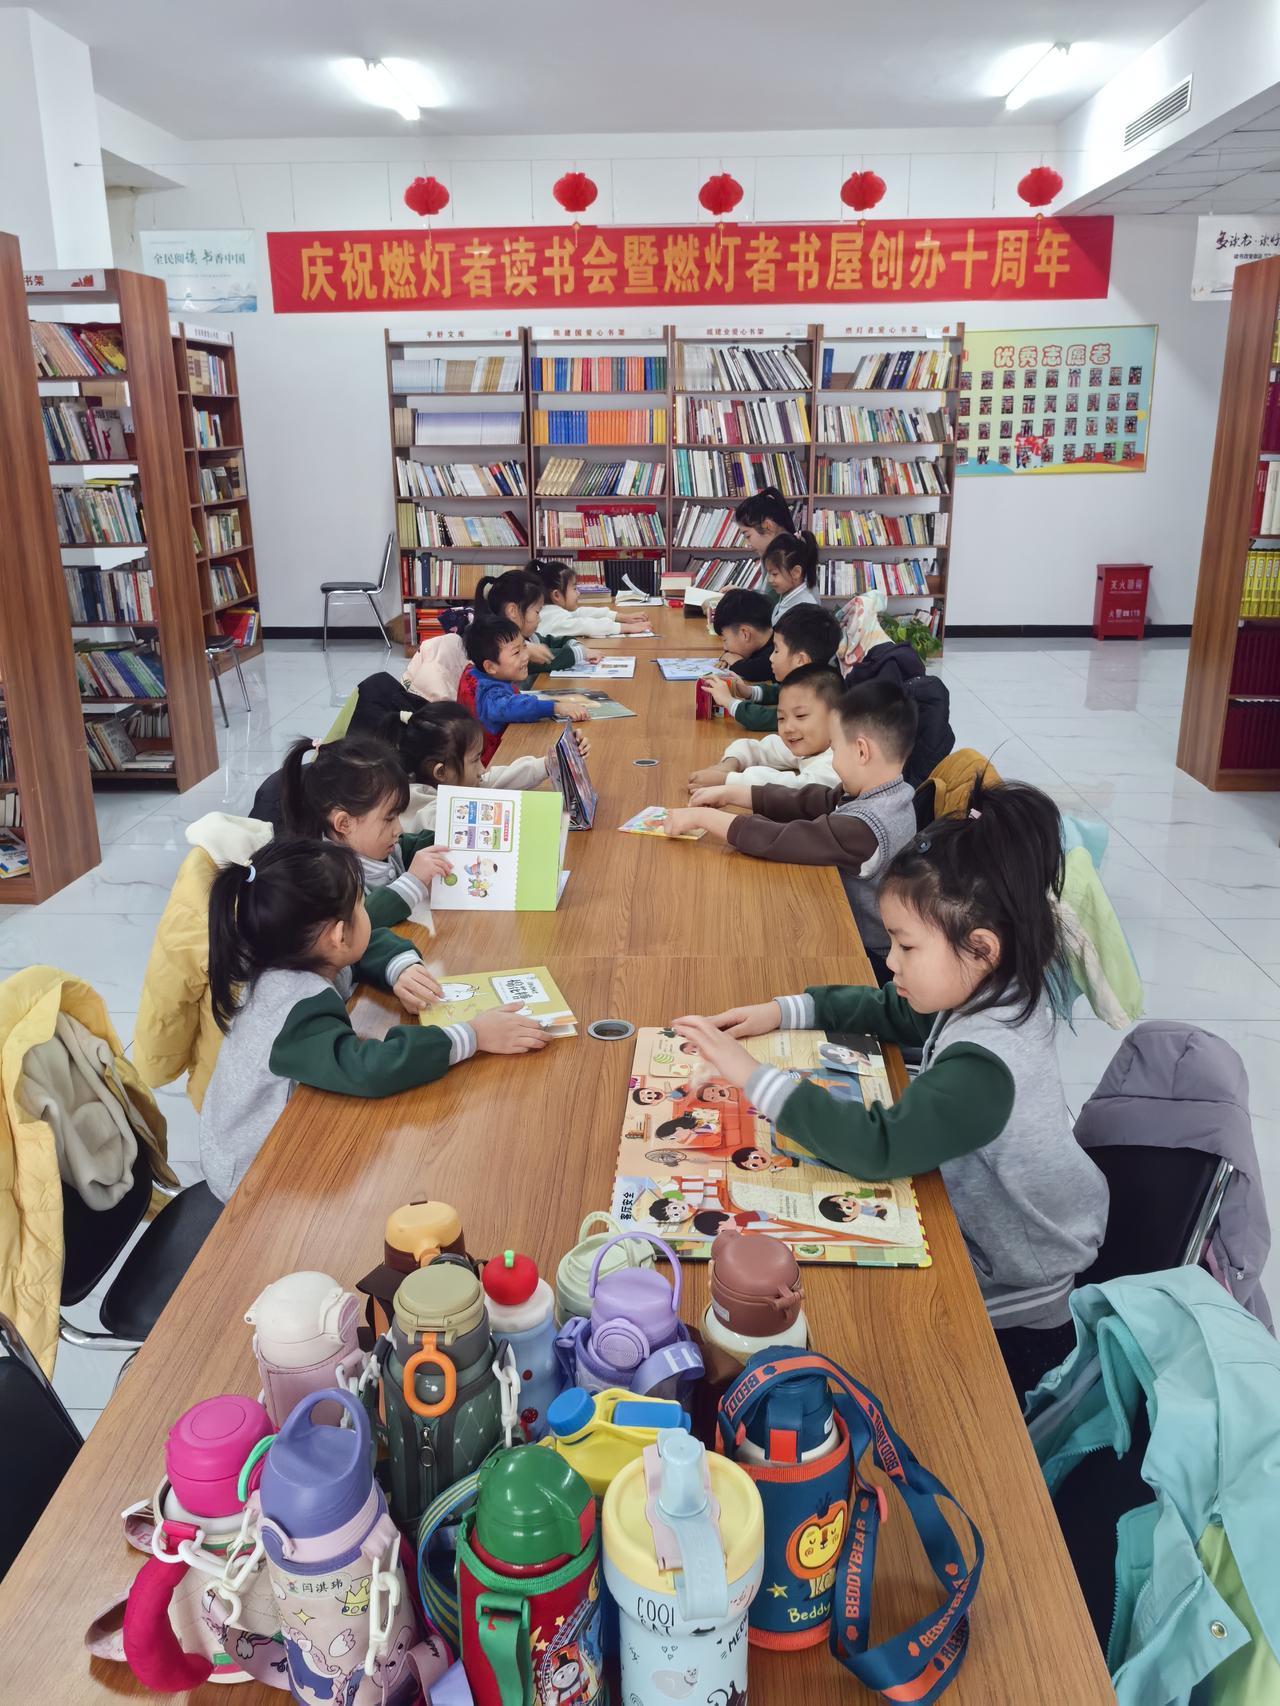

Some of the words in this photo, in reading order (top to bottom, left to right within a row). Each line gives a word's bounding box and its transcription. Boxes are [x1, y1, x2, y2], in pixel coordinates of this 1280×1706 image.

[301, 228, 1070, 301] 庆祝燃灯者读书会暨燃灯者书屋创办十周年
[994, 343, 1110, 368] 优秀志愿者
[845, 1519, 867, 1619] BEDDYBEAR
[787, 1602, 831, 1624] Beddy
